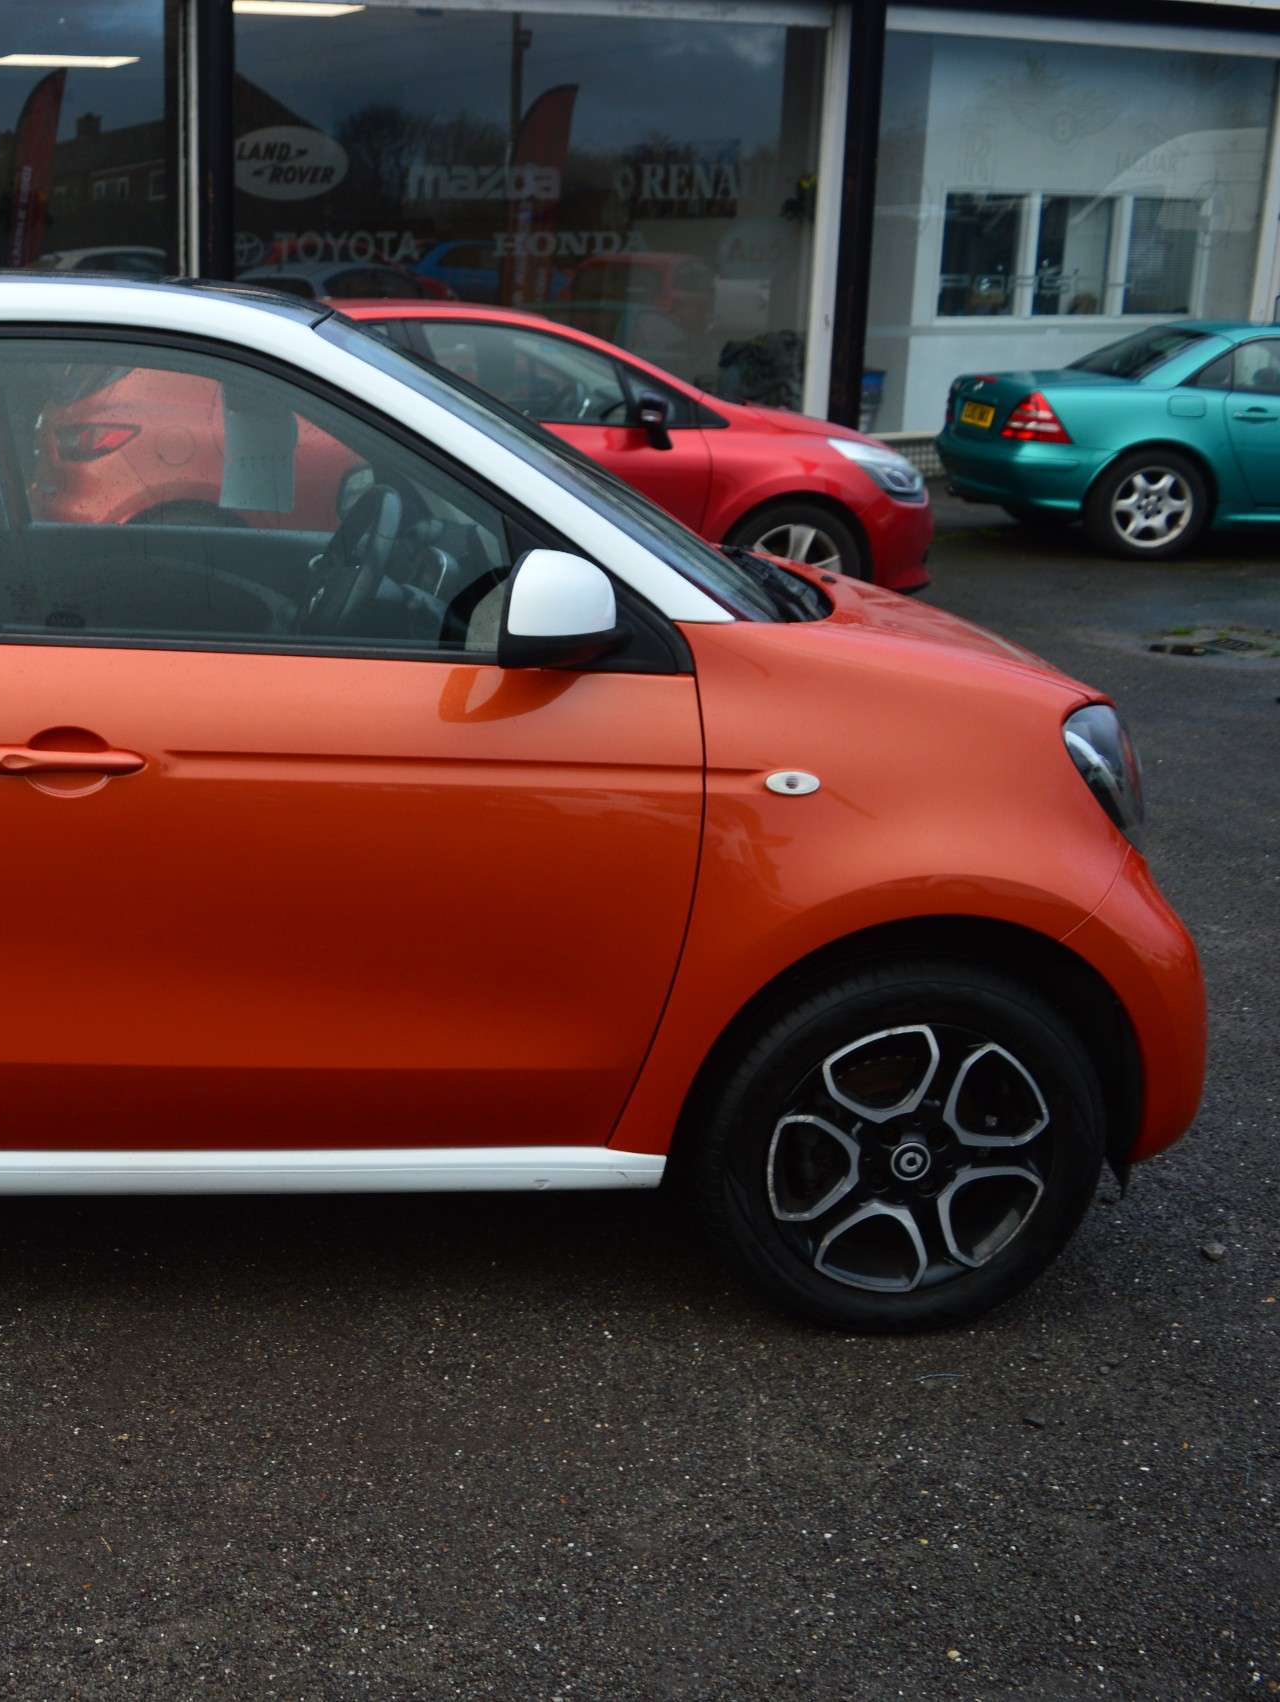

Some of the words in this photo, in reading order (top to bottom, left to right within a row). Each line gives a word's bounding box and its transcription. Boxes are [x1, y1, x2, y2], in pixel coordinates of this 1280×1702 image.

[236, 141, 291, 161] LAND
[268, 165, 336, 185] ROVER
[407, 162, 560, 199] mazda
[639, 163, 772, 200] RENA
[274, 231, 422, 264] TOYOTA
[493, 230, 650, 258] HONDA
